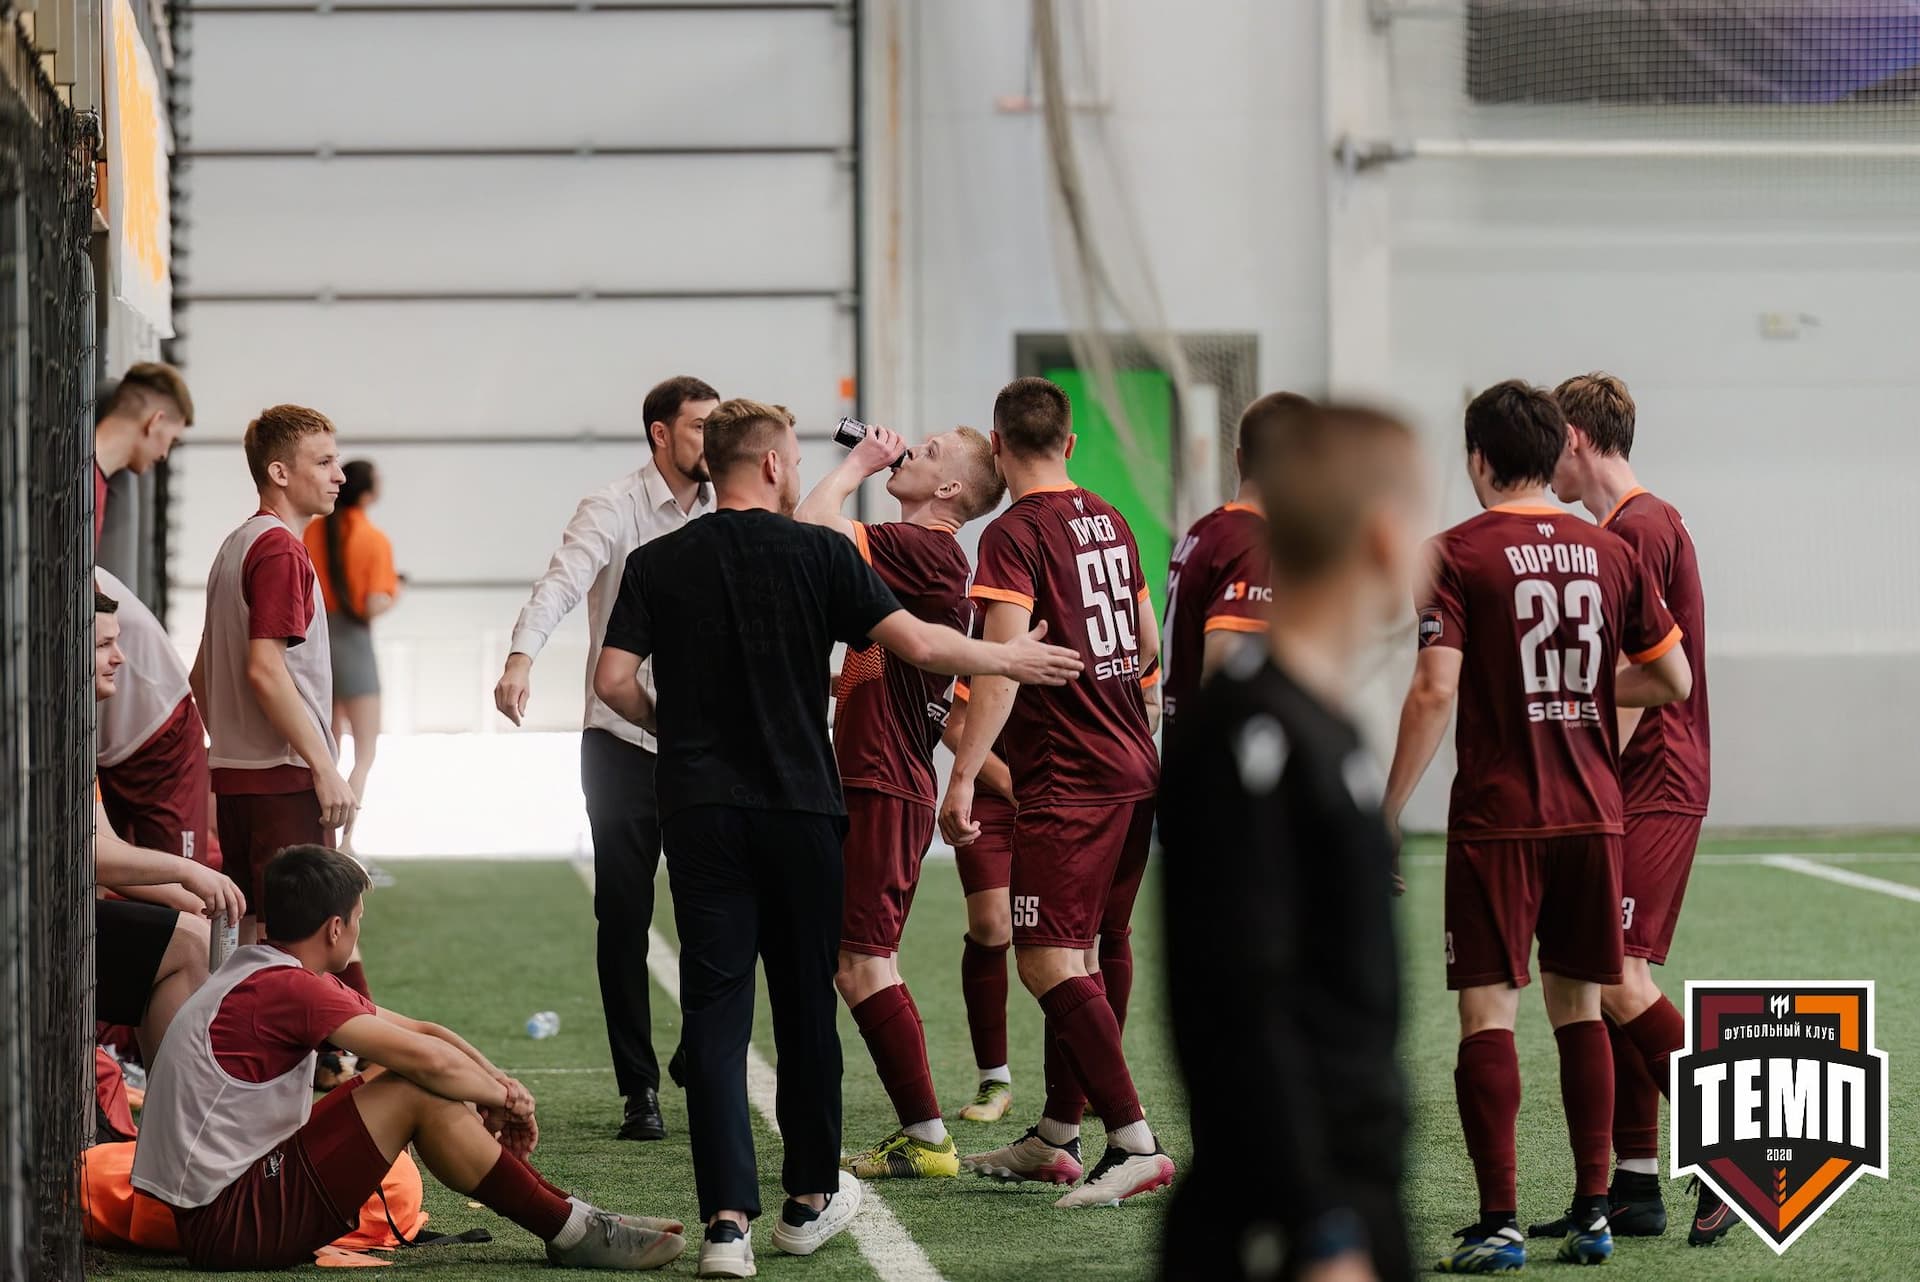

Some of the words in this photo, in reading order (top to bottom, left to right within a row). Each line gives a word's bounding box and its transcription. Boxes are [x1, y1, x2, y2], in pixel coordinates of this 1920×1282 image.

[1504, 544, 1599, 576] ВОРОНА
[1076, 544, 1138, 657] 55
[1514, 579, 1605, 694] 23
[1528, 700, 1600, 722] SEUS
[1014, 895, 1040, 927] 55
